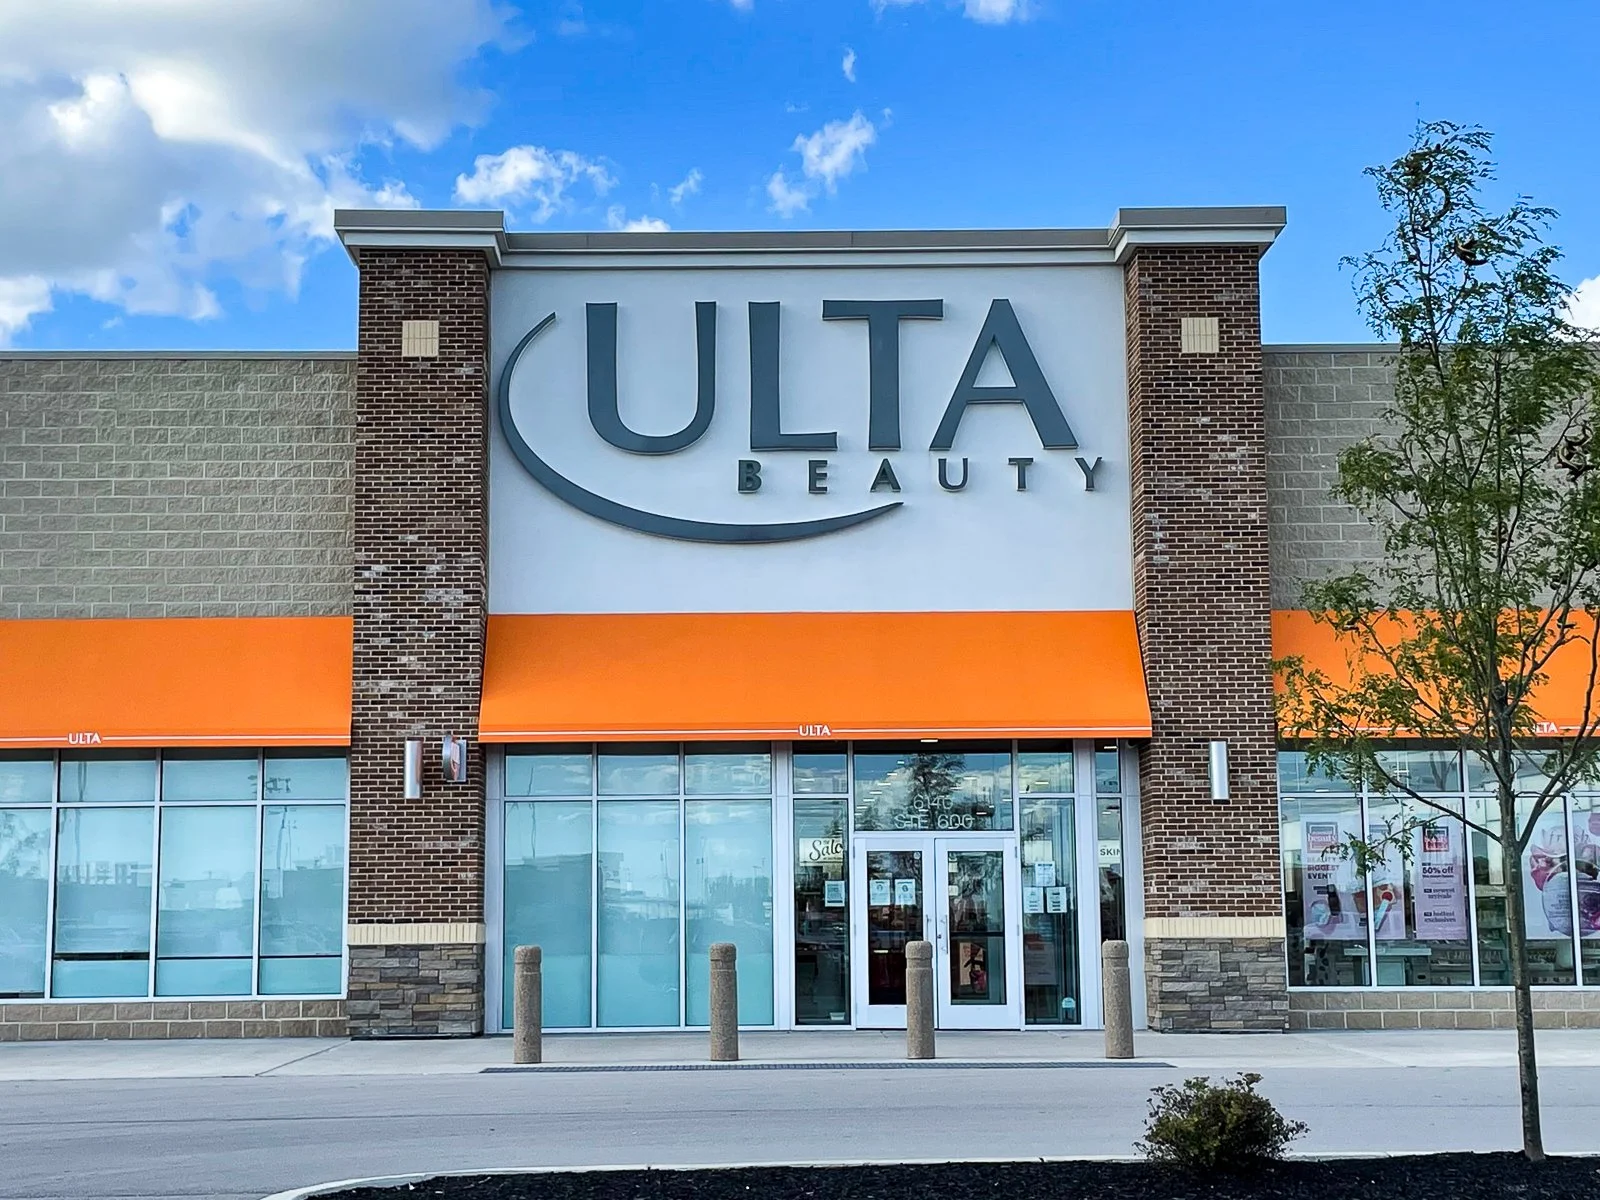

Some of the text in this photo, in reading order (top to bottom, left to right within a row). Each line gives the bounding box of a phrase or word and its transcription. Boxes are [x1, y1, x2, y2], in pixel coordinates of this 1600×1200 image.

[585, 298, 1079, 456] ULTA
[738, 456, 1103, 494] BEAUTY
[799, 724, 831, 736] ULTA
[68, 732, 102, 745] ULTA
[894, 813, 974, 829] STE 600
[1307, 872, 1333, 880] EVENT
[1442, 866, 1454, 874] off
